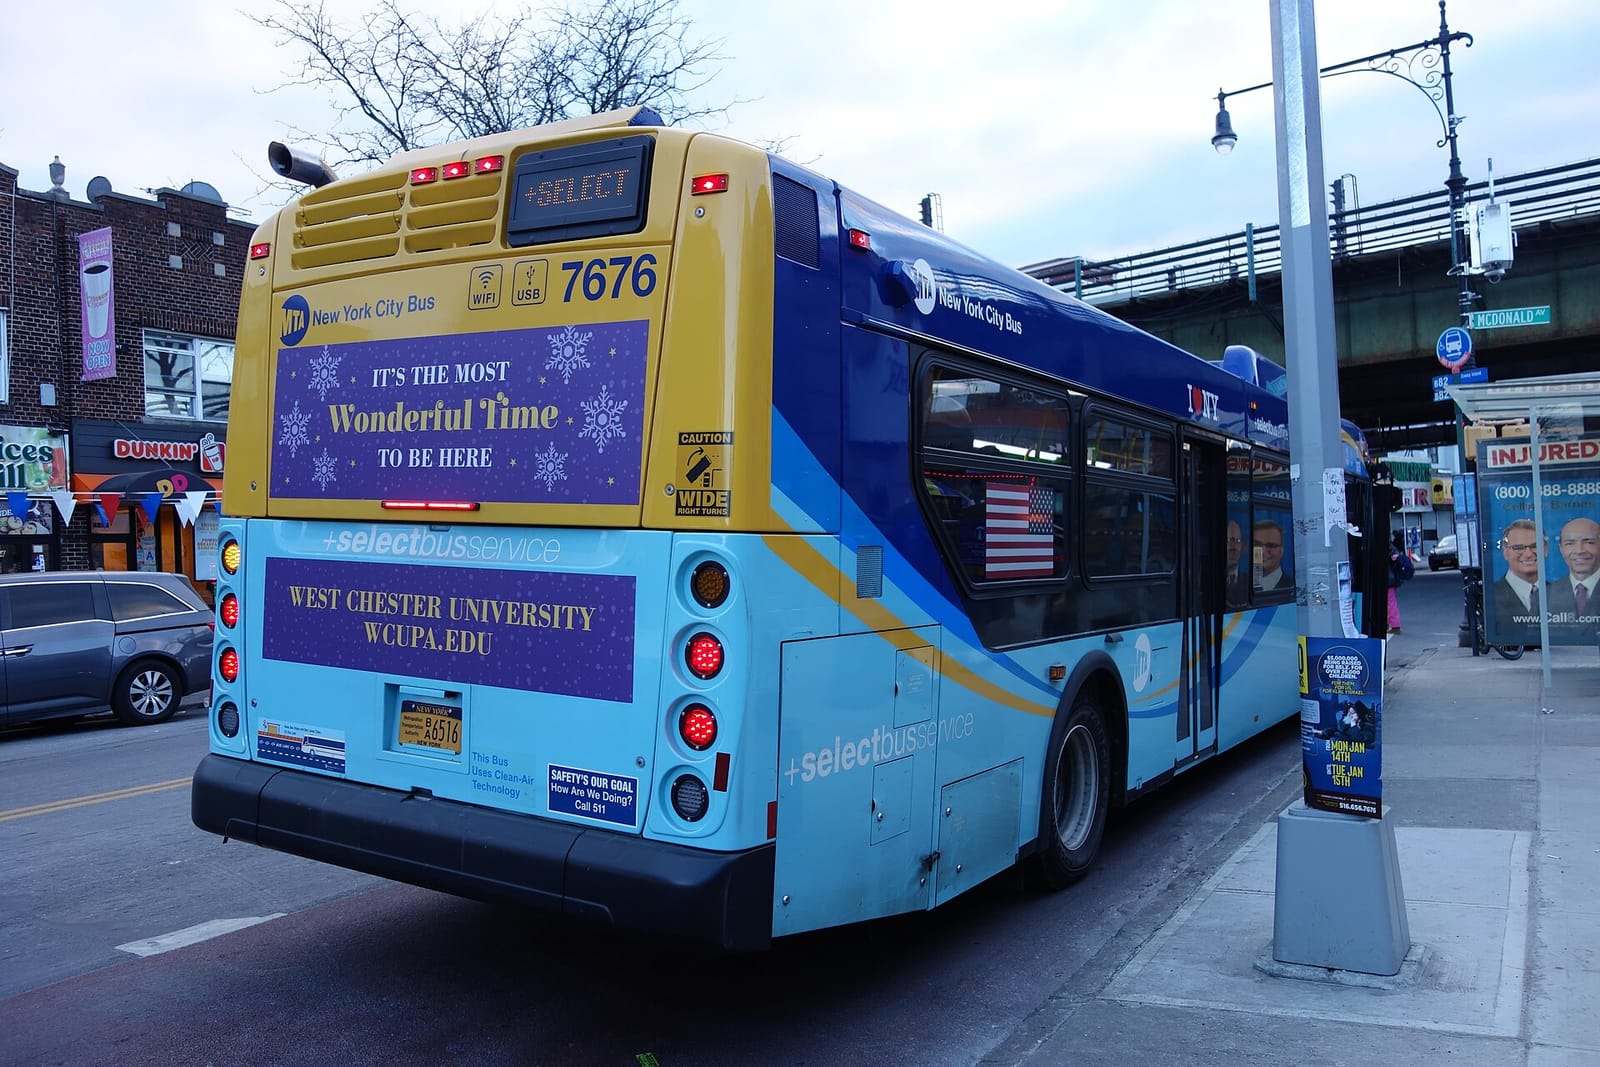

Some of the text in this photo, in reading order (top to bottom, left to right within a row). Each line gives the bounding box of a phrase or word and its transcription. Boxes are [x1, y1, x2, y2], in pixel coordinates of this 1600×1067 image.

[562, 254, 658, 303] 7676
[473, 293, 496, 305] WIFI
[517, 288, 540, 301] USB
[313, 305, 341, 327] New
[342, 301, 373, 322] York
[376, 296, 403, 320] City
[408, 294, 435, 312] Bus
[938, 286, 961, 312] New
[962, 295, 984, 320] York
[986, 304, 1004, 330] City
[1006, 312, 1022, 334] Bus
[1477, 310, 1534, 327] MCDONALD
[88, 339, 110, 356] NOW
[87, 354, 110, 370] OPEN
[372, 361, 510, 388] IT'S THE MOST
[328, 391, 559, 434] Wonderful Time
[1202, 390, 1218, 421] NY
[681, 433, 731, 444] CAUTION
[116, 440, 198, 461] DUNKIN'
[378, 448, 493, 468] TO BE HERE
[679, 491, 728, 507] WIDE
[1495, 486, 1530, 500] (800)
[288, 585, 596, 632] WEST CHESTER UNIVERSITY
[364, 621, 493, 656] WCUPA.EDU
[432, 706, 449, 716] YORK
[432, 719, 458, 744] 6516
[1331, 740, 1348, 751] MON
[1349, 742, 1364, 753] JAN
[472, 752, 508, 767] This Bus
[1332, 751, 1350, 762] 14TH
[472, 766, 534, 786] Uses Clean-Air
[1332, 764, 1346, 776] TUE
[1348, 766, 1363, 778] JAN
[472, 780, 520, 800] Technology
[551, 769, 634, 793] SAFETY'S OUR GOAL
[1332, 776, 1350, 787] 15TH
[551, 782, 633, 806] How Are We Doing?
[575, 800, 606, 814] Call 511
